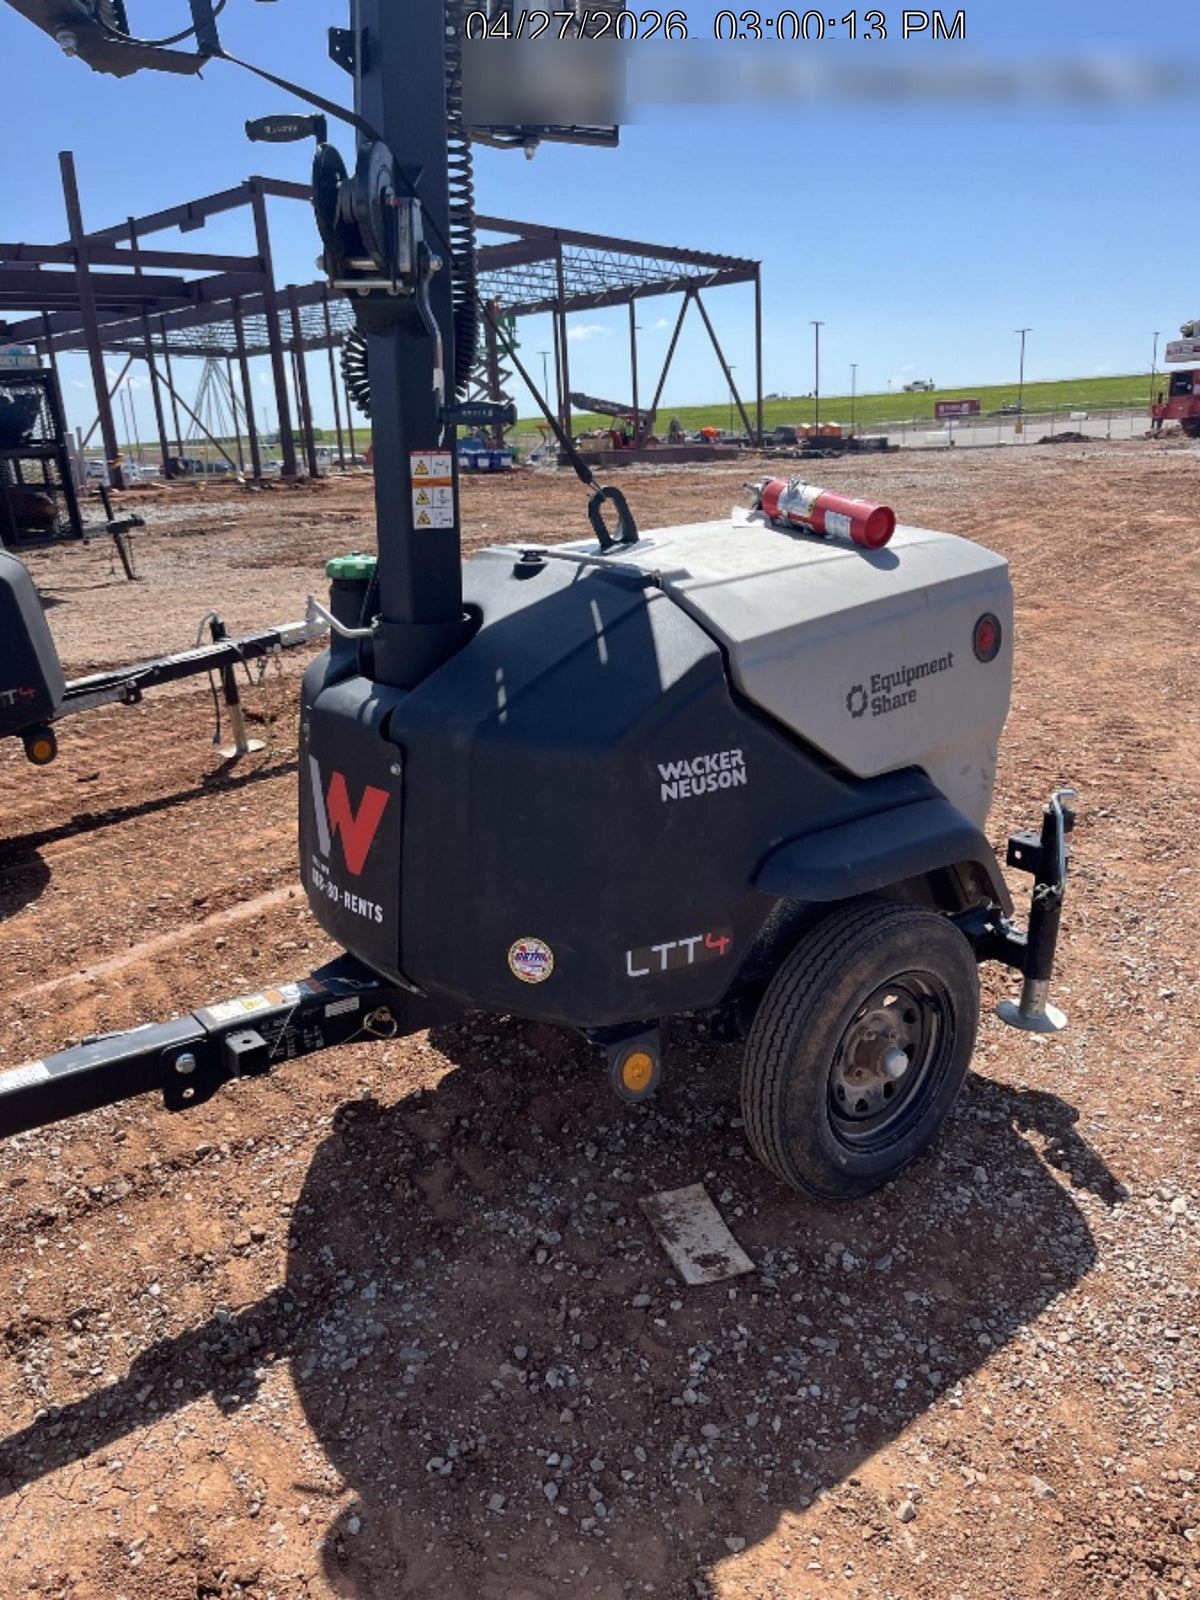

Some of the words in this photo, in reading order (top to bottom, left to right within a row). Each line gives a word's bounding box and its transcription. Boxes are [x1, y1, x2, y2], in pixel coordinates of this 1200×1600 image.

[870, 651, 954, 694] Equipment
[871, 689, 917, 717] Share
[657, 748, 746, 781] WACKER
[660, 765, 747, 802] NEUSON
[625, 932, 730, 977] LTT4
